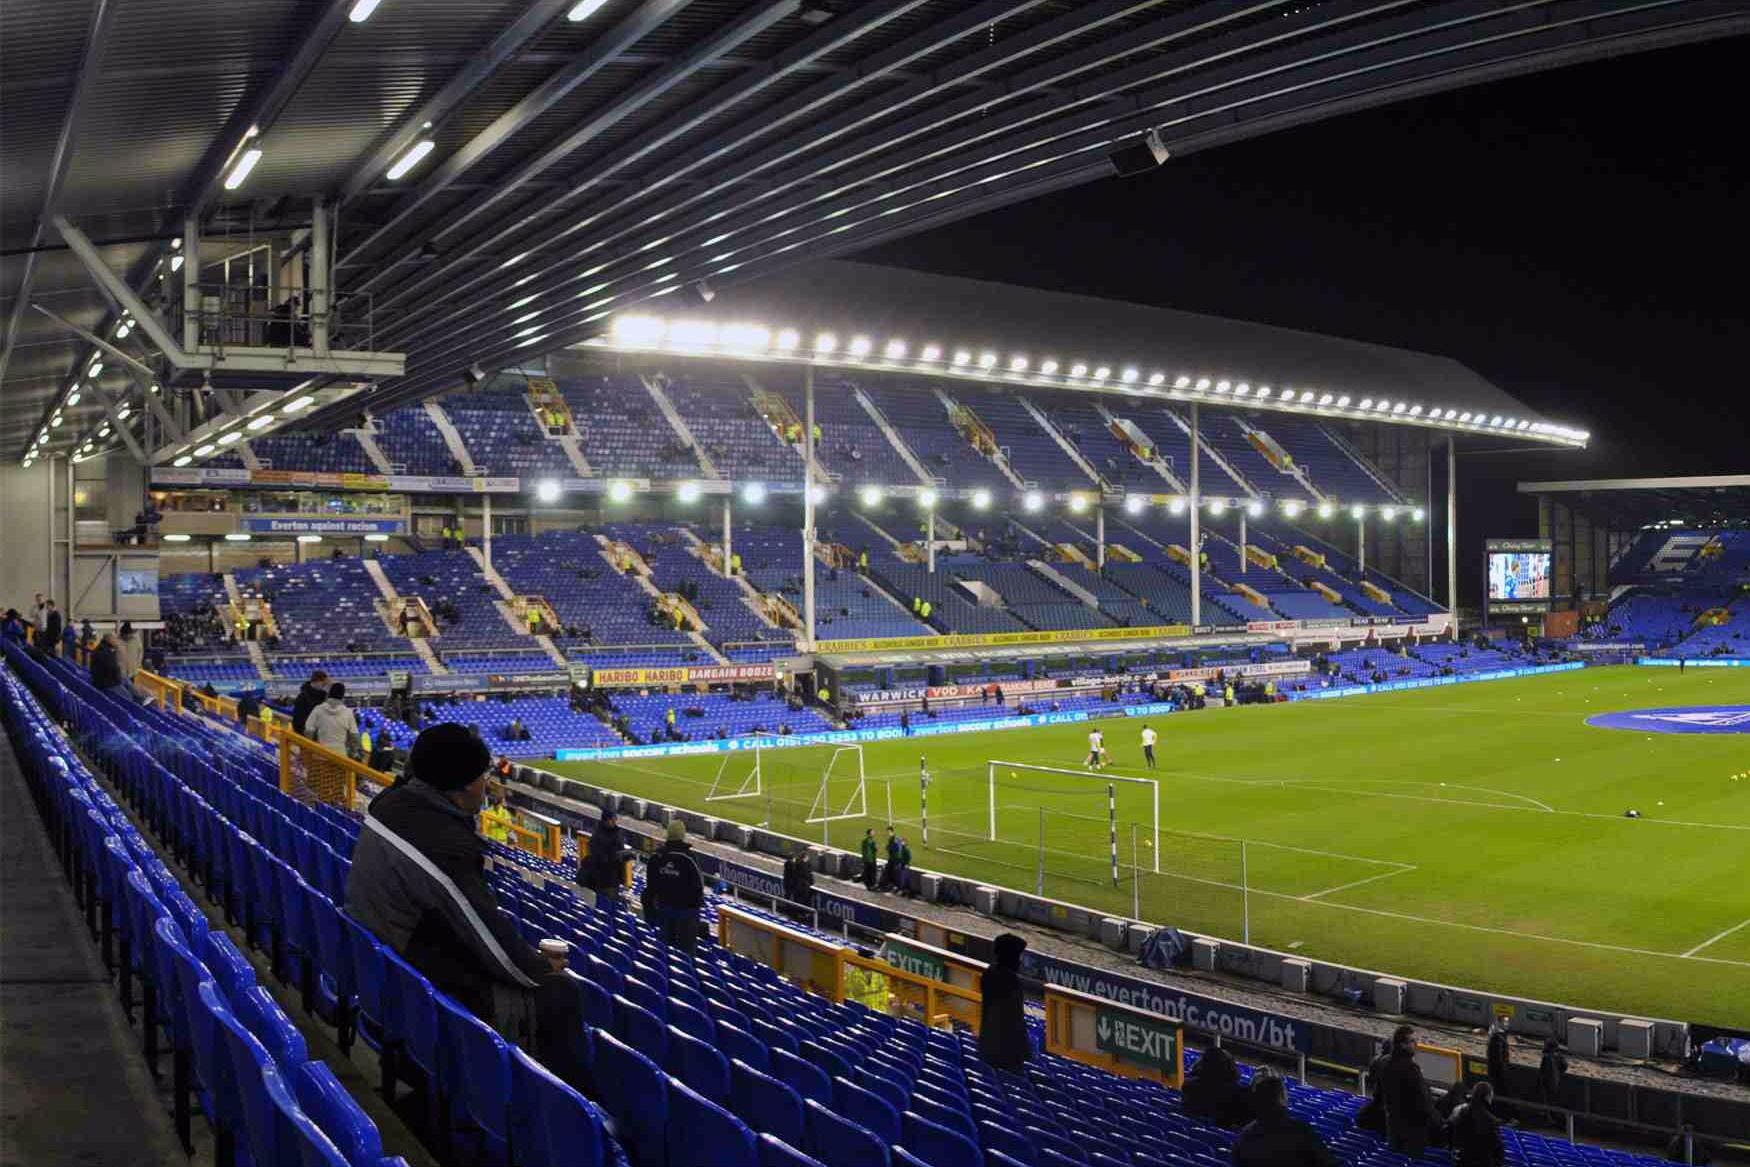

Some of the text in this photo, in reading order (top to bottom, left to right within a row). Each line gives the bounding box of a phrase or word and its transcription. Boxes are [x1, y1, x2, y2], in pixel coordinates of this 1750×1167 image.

[272, 520, 308, 531] Everton
[600, 669, 682, 683] HARIBO HARIBO
[689, 664, 772, 679] BARGAIN BOOZE
[859, 690, 927, 702] WARWICK
[1050, 714, 1073, 723] CALL
[744, 738, 773, 748] CALL
[862, 731, 875, 739] TO
[886, 949, 921, 975] EXIT
[1044, 966, 1296, 1050] www.evertonfc.com/bt
[1126, 1023, 1175, 1061] EXIT
